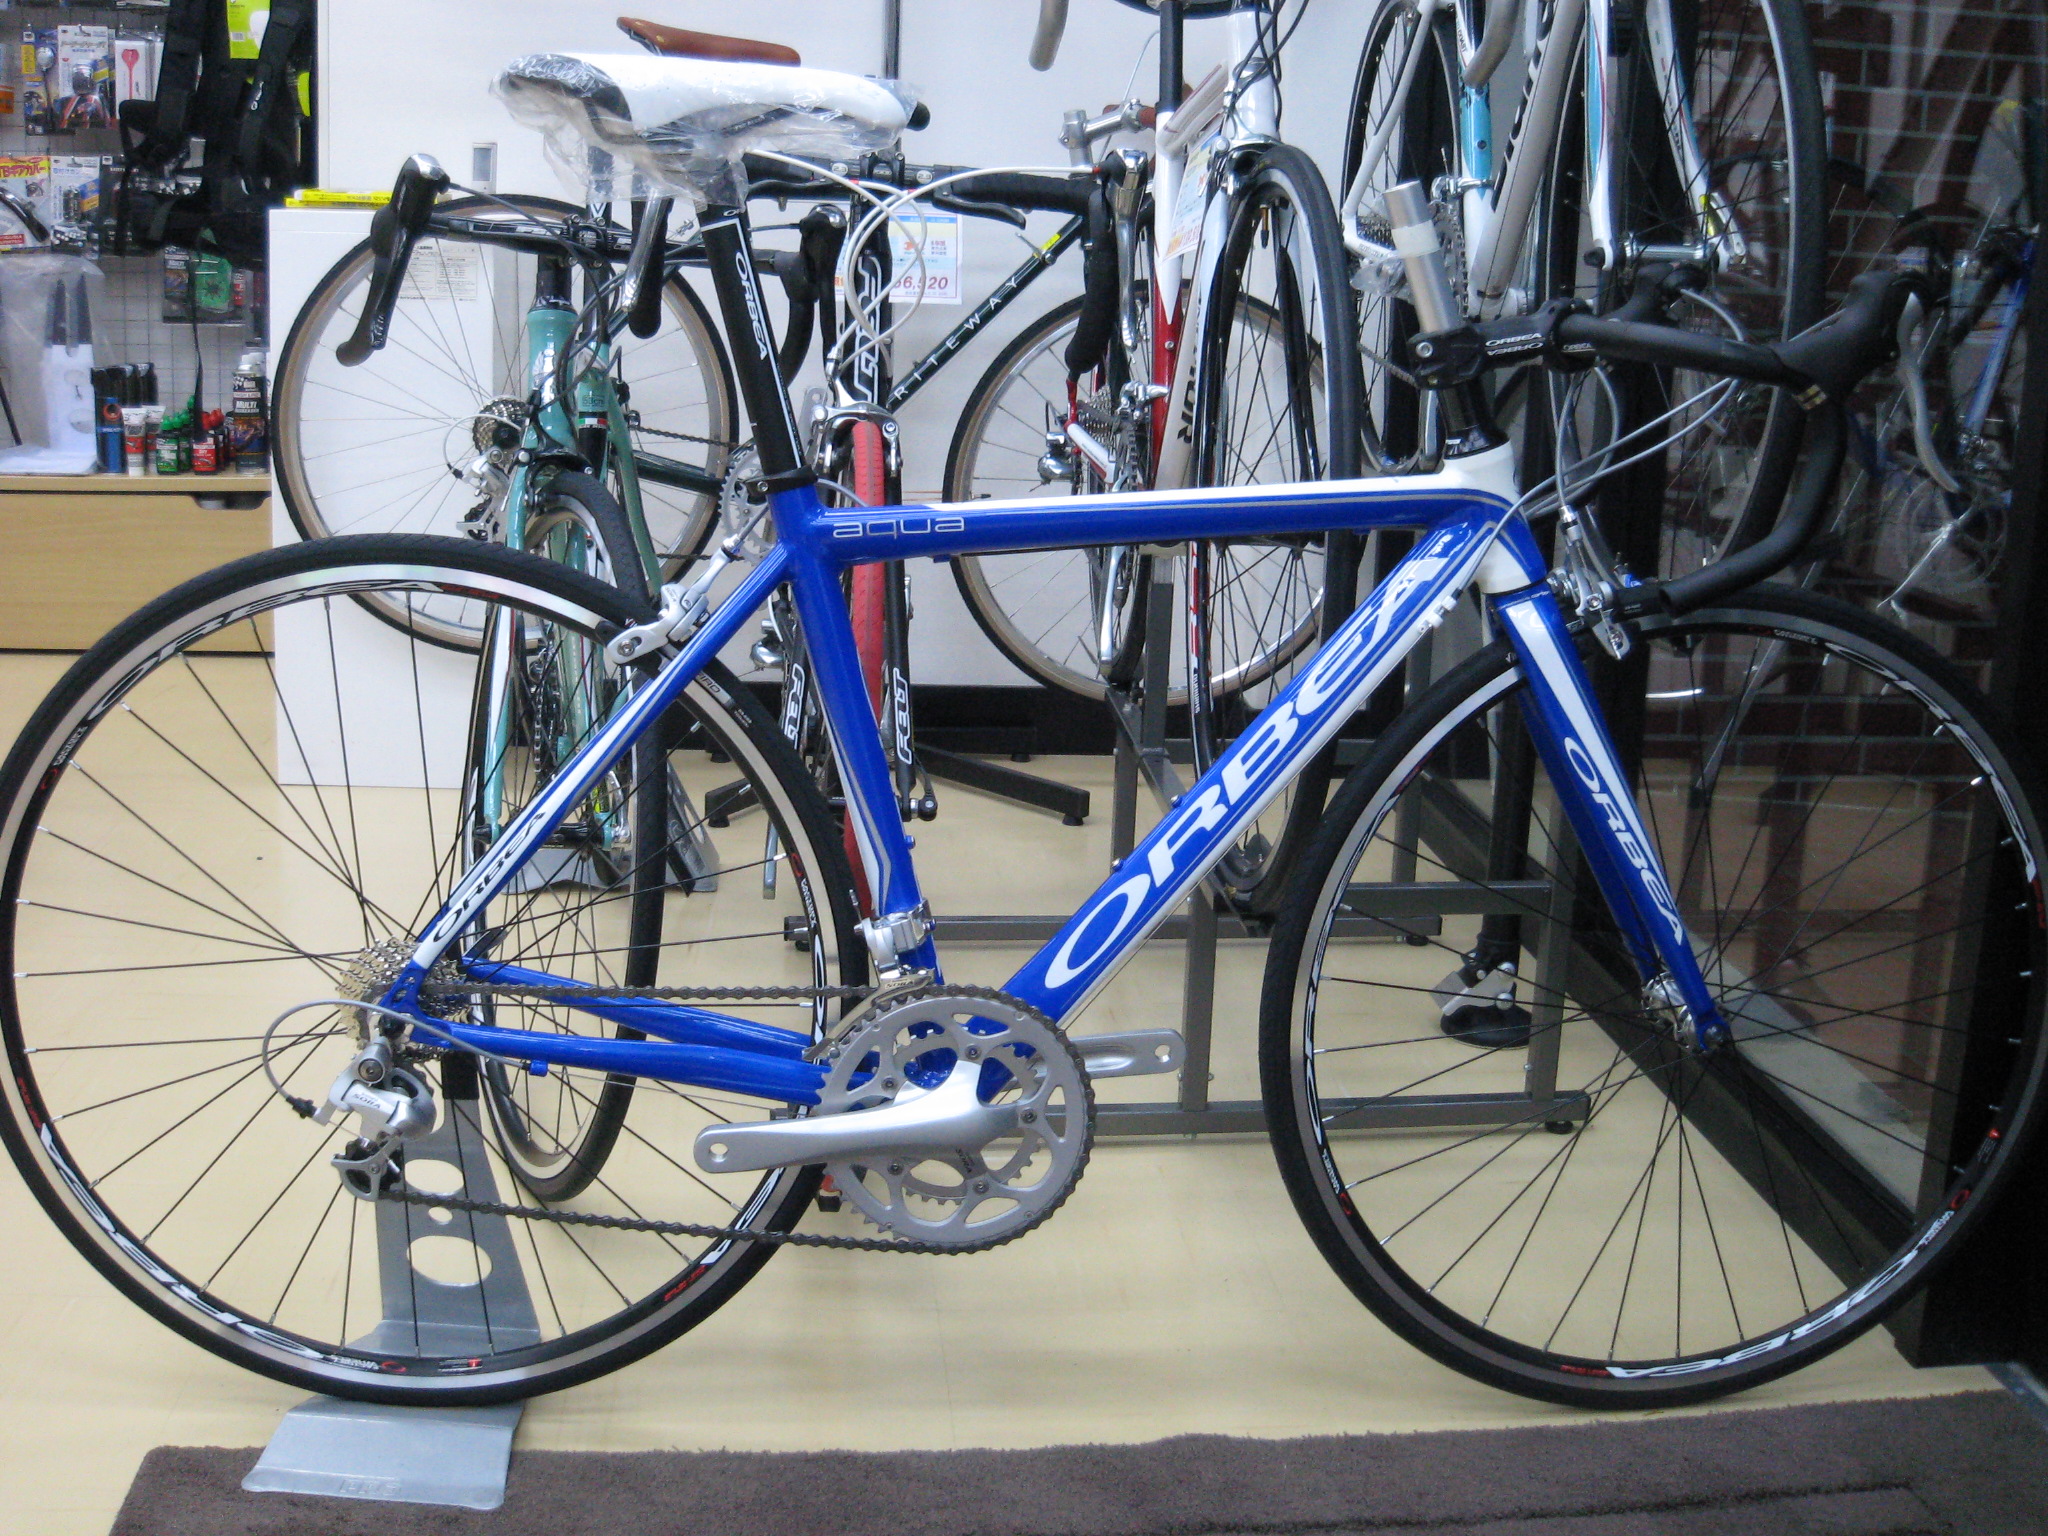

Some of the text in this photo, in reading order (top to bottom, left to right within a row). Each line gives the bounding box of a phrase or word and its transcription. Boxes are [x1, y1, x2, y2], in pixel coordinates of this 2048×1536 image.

[735, 251, 768, 361] ORBEA
[894, 276, 1019, 401] RITEWAY
[1485, 332, 1543, 347] ORBEA
[832, 516, 965, 540] aqua
[88, 579, 444, 721] ORBEA
[892, 667, 914, 765] FELT
[1045, 556, 1450, 989] ORBEA
[1825, 641, 2038, 883] ORBEA
[433, 812, 546, 943] ORBEA
[1563, 736, 1683, 946] ORBEA
[1605, 1249, 1919, 1379] ORBEA
